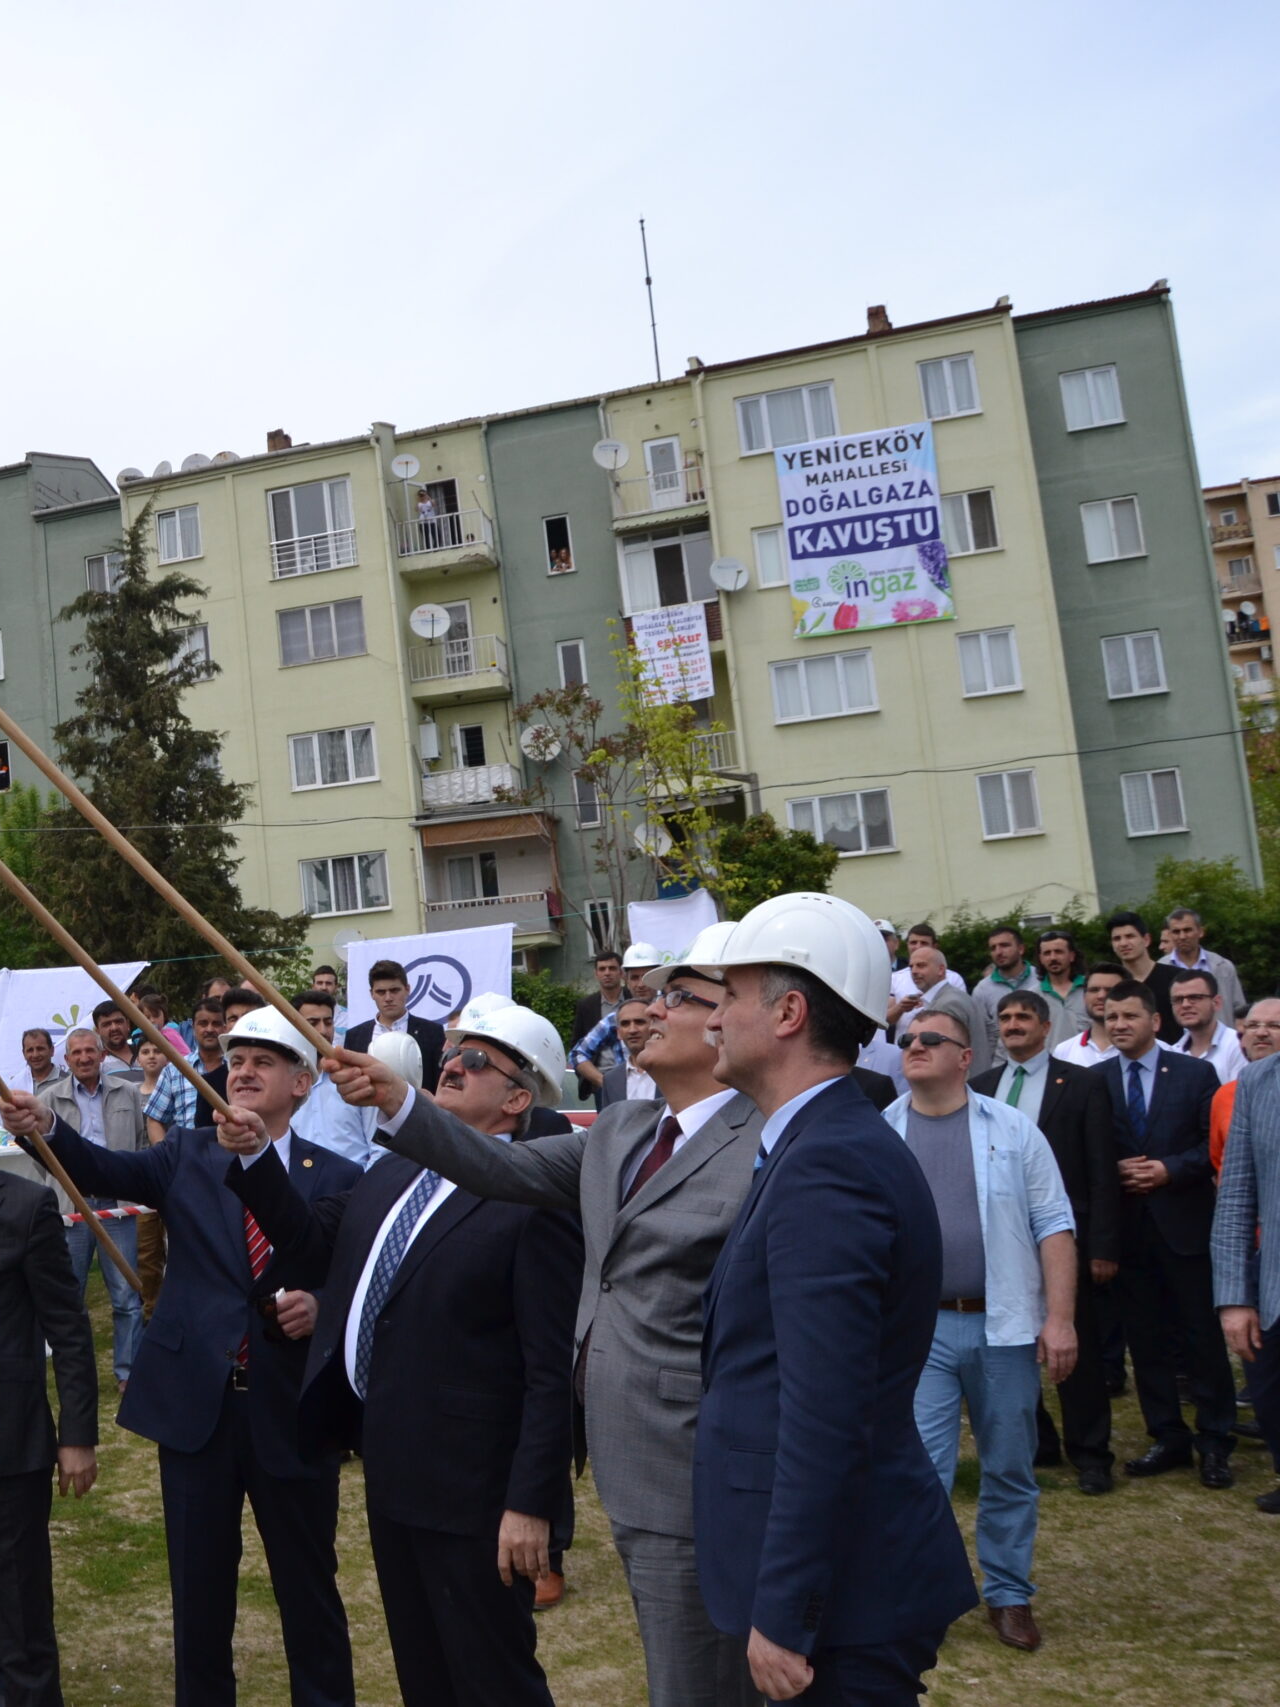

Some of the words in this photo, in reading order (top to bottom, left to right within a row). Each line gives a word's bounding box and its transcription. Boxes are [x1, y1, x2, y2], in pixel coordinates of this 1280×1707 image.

[782, 429, 925, 470] YENİCEKÖY
[805, 458, 908, 487] MAHALLESİ
[785, 479, 934, 518] DOĞALGAZA
[793, 509, 935, 555] KAVUŞTU
[844, 570, 918, 603] ingaz
